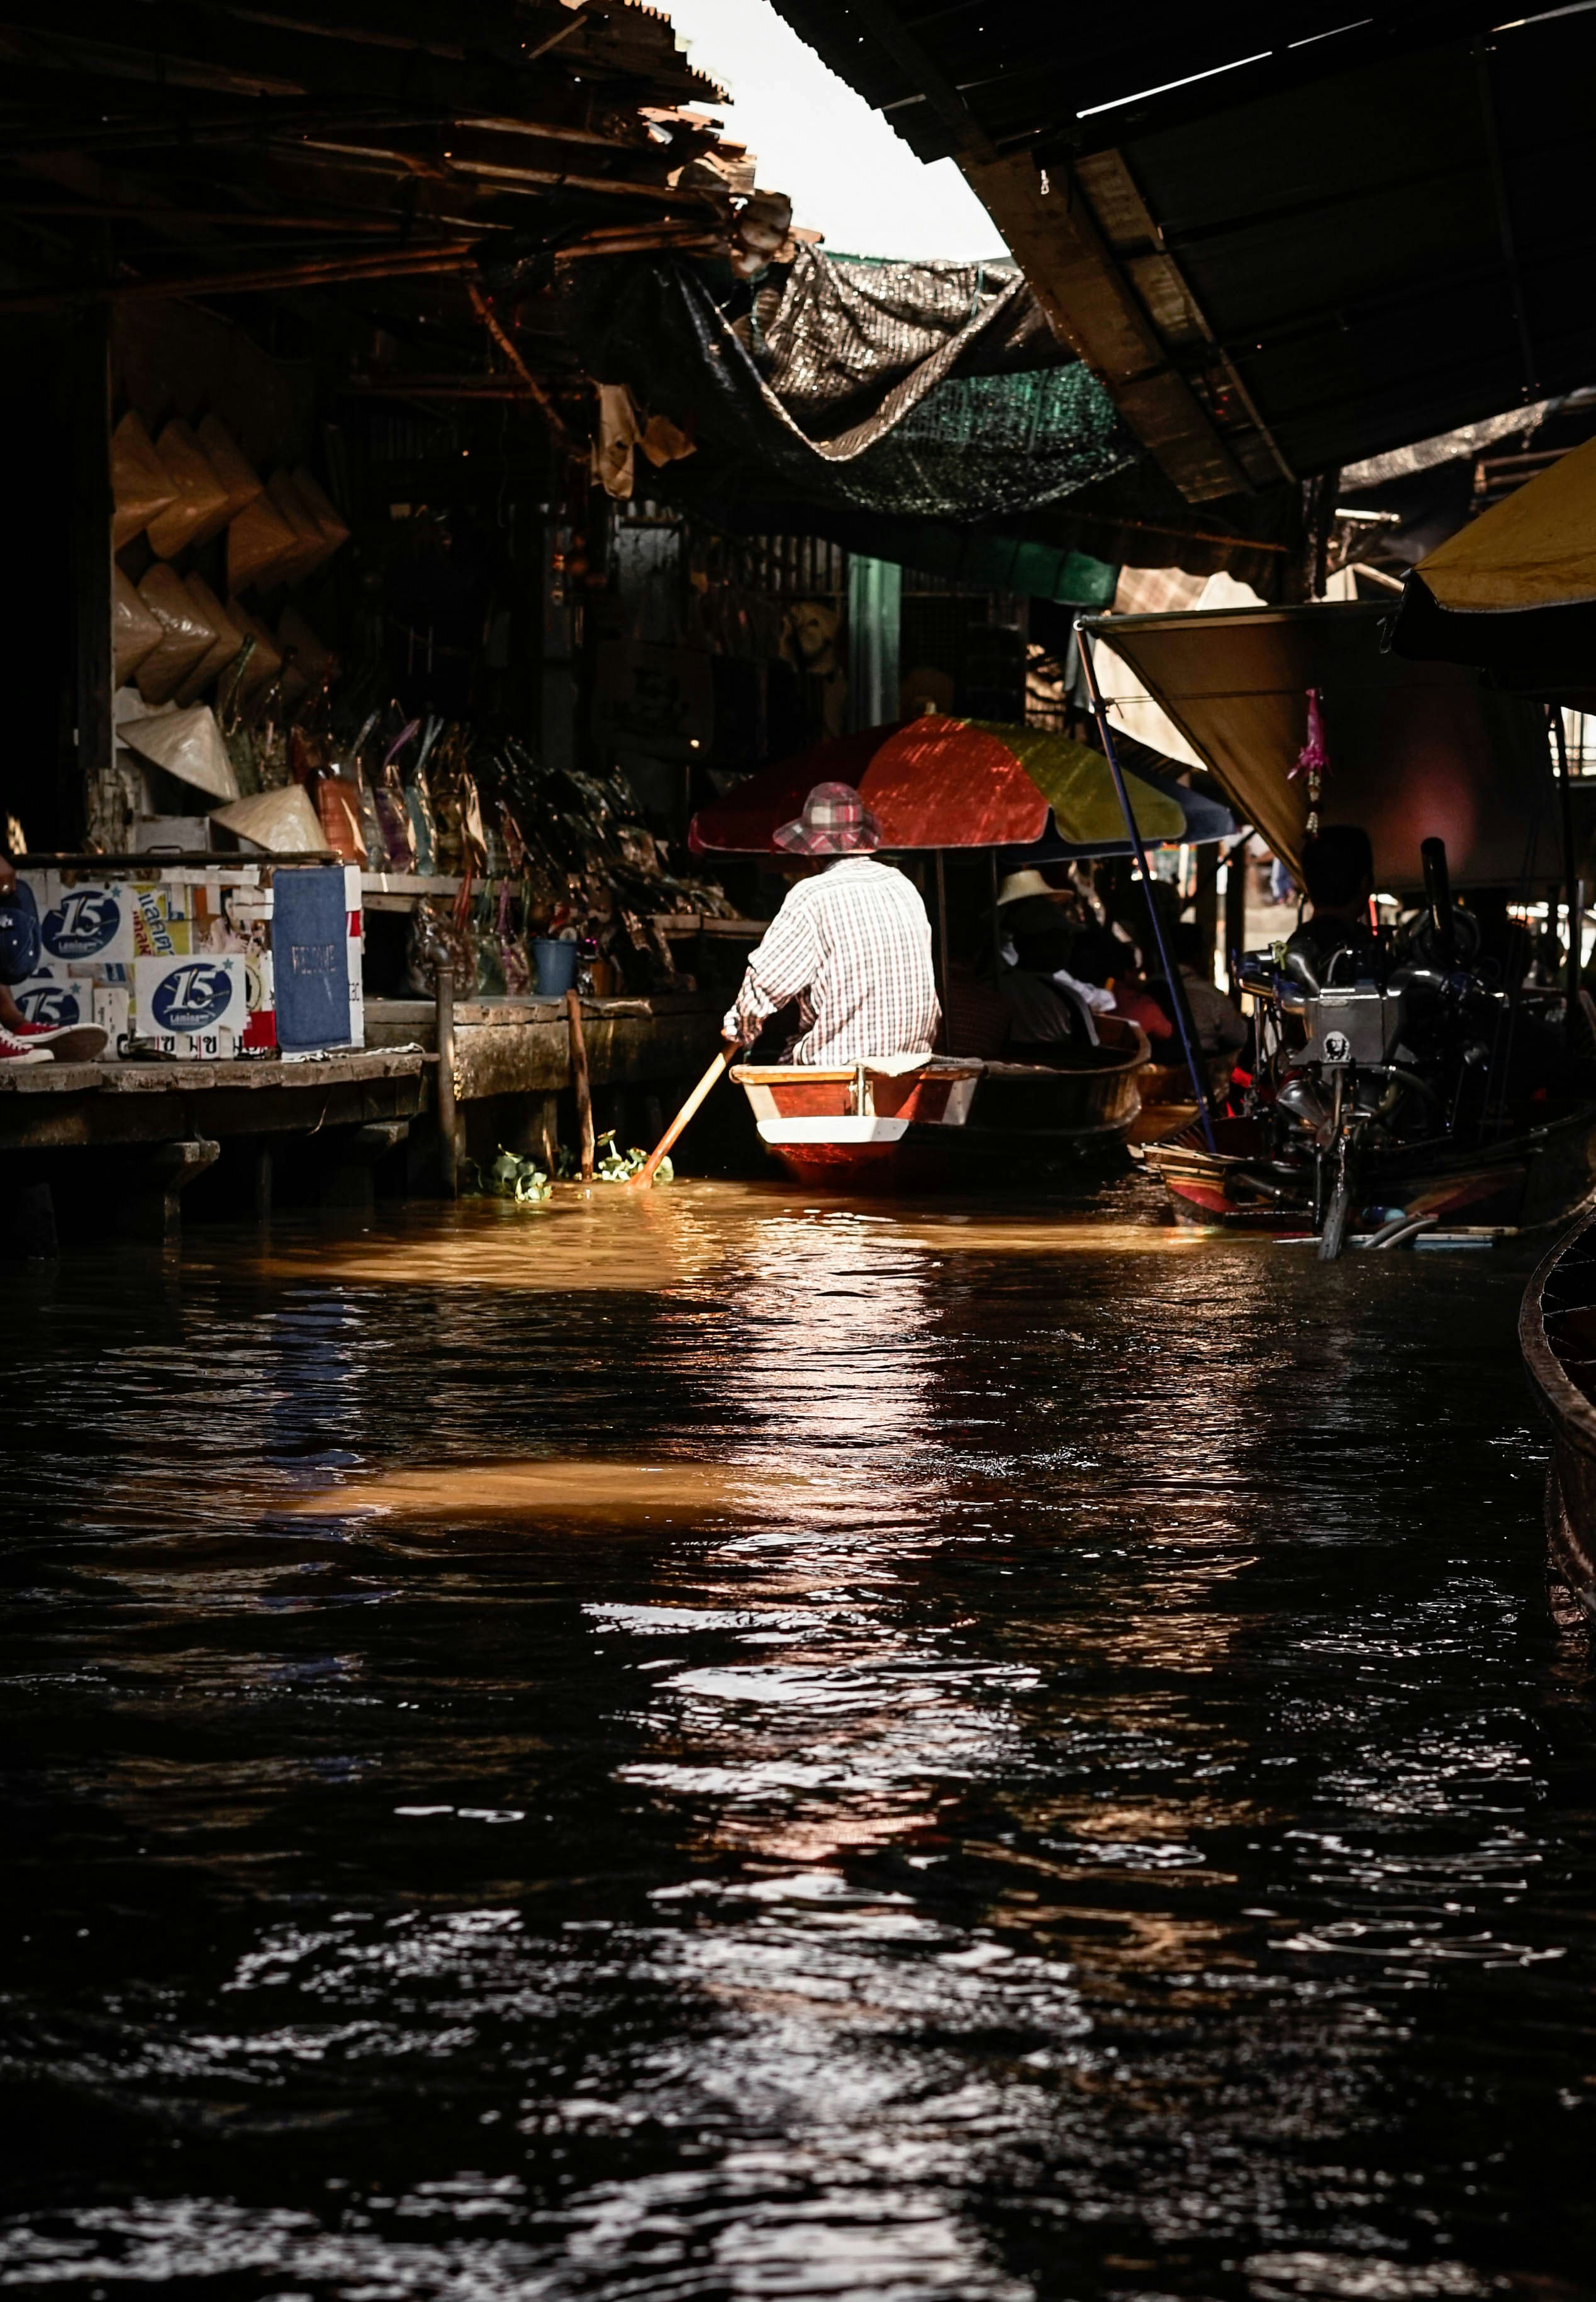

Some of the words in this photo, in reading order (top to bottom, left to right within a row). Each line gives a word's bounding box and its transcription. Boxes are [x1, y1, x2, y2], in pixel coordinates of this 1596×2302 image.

[55, 897, 104, 937] 15
[21, 993, 64, 1024] 15
[166, 971, 216, 1009] 15
